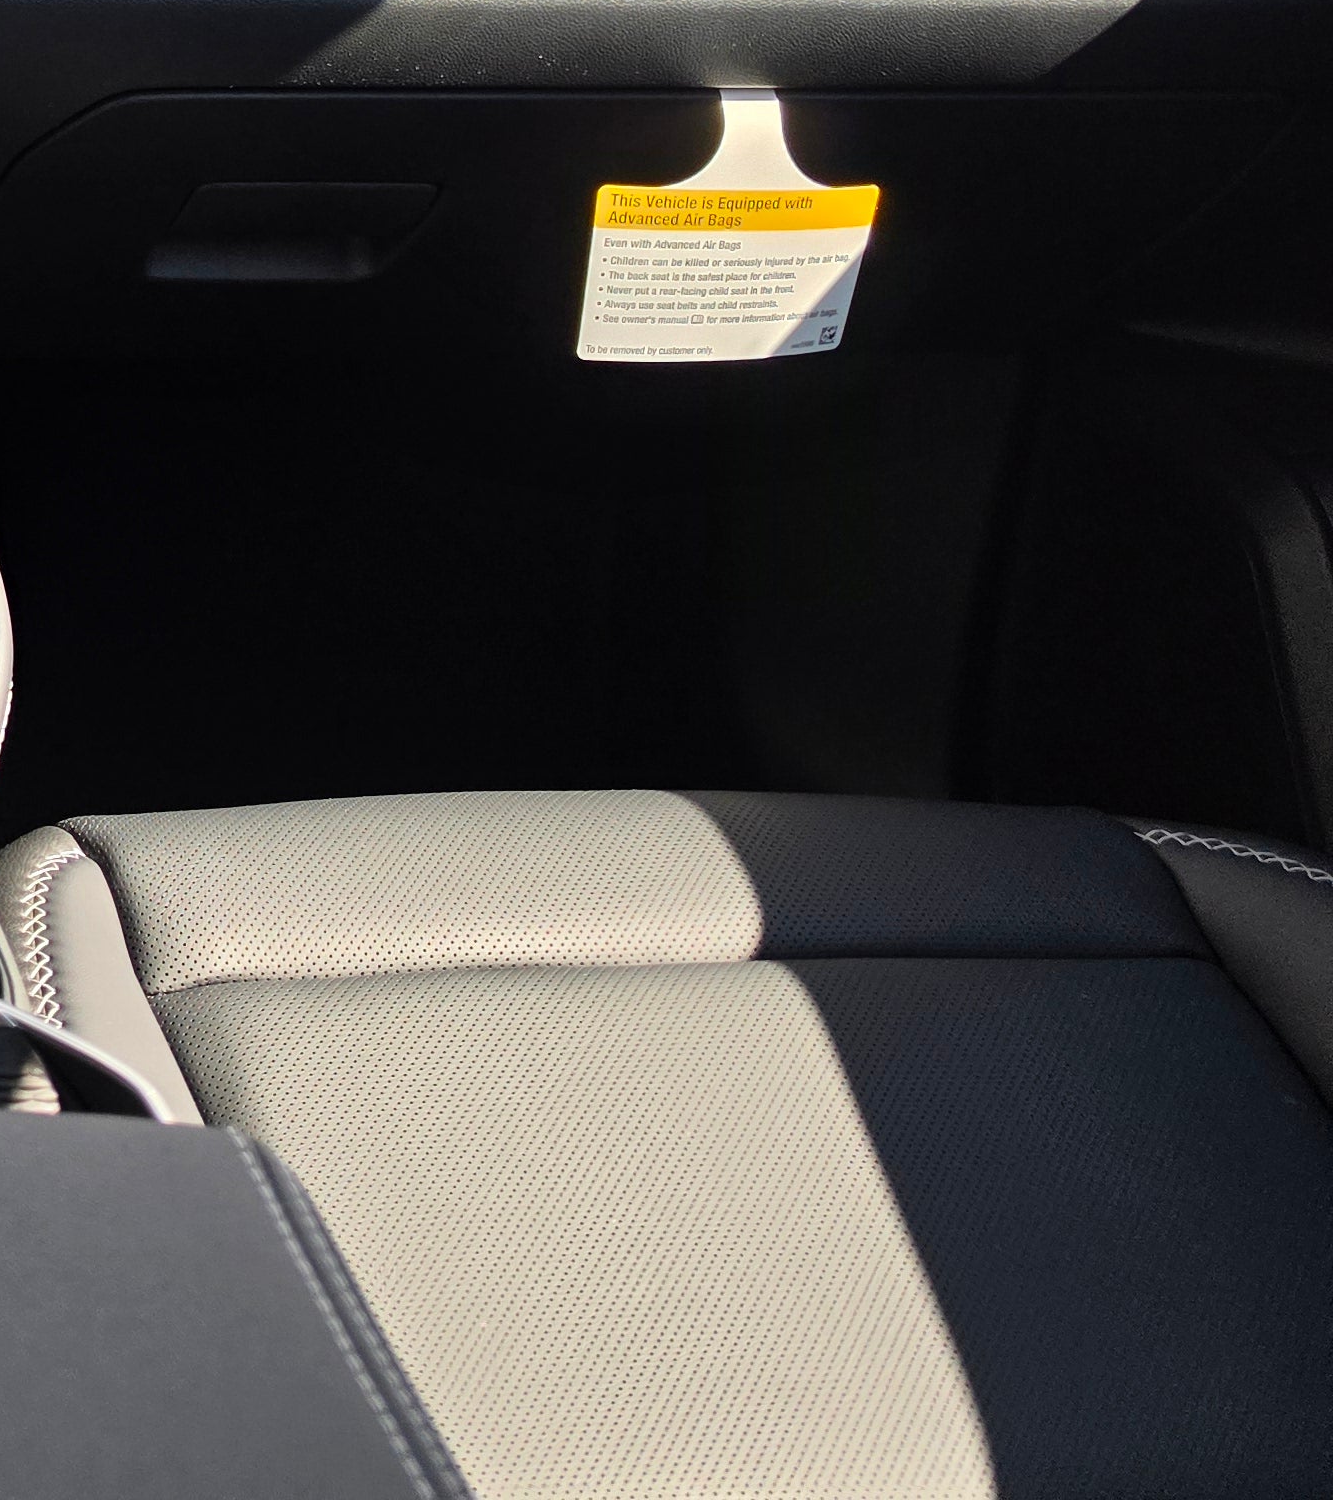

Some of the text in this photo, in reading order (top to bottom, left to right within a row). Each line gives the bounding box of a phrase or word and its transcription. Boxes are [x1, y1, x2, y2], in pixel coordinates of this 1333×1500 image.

[611, 193, 813, 213] This Vehicle is Equipped with
[608, 211, 742, 229] Advanced Air Bags
[603, 237, 741, 252] Even with Advanced Air Bags
[610, 255, 649, 266] Children
[652, 258, 670, 267] can
[671, 257, 683, 267] be
[685, 257, 710, 267] killed
[712, 259, 721, 267] or
[723, 257, 763, 268] seriously
[796, 257, 806, 267] by
[807, 256, 820, 265] the
[821, 255, 833, 263] air
[609, 270, 625, 280] The
[627, 271, 649, 281] back
[651, 272, 670, 281] seat
[671, 272, 680, 281] is
[682, 272, 695, 281] the
[697, 272, 724, 282] safest
[725, 272, 748, 283] place
[750, 271, 761, 281] for
[606, 285, 632, 295] Never
[634, 286, 650, 297] put
[659, 286, 707, 298] rear-facing
[708, 286, 729, 296] child
[731, 286, 748, 295] seat
[750, 285, 758, 295] in
[760, 285, 773, 294] the
[604, 300, 636, 311] Always
[638, 302, 654, 310] use
[656, 301, 675, 310] seat
[699, 301, 716, 310] and
[717, 300, 737, 310] child
[603, 313, 619, 323] See
[621, 315, 656, 324] owner's
[657, 315, 689, 325] manual
[706, 315, 718, 325] for
[719, 316, 741, 324] more
[742, 312, 785, 324] information
[585, 343, 596, 354] To
[597, 344, 608, 354] be
[609, 345, 646, 356] removed
[647, 346, 658, 357] by
[658, 346, 695, 356] customer
